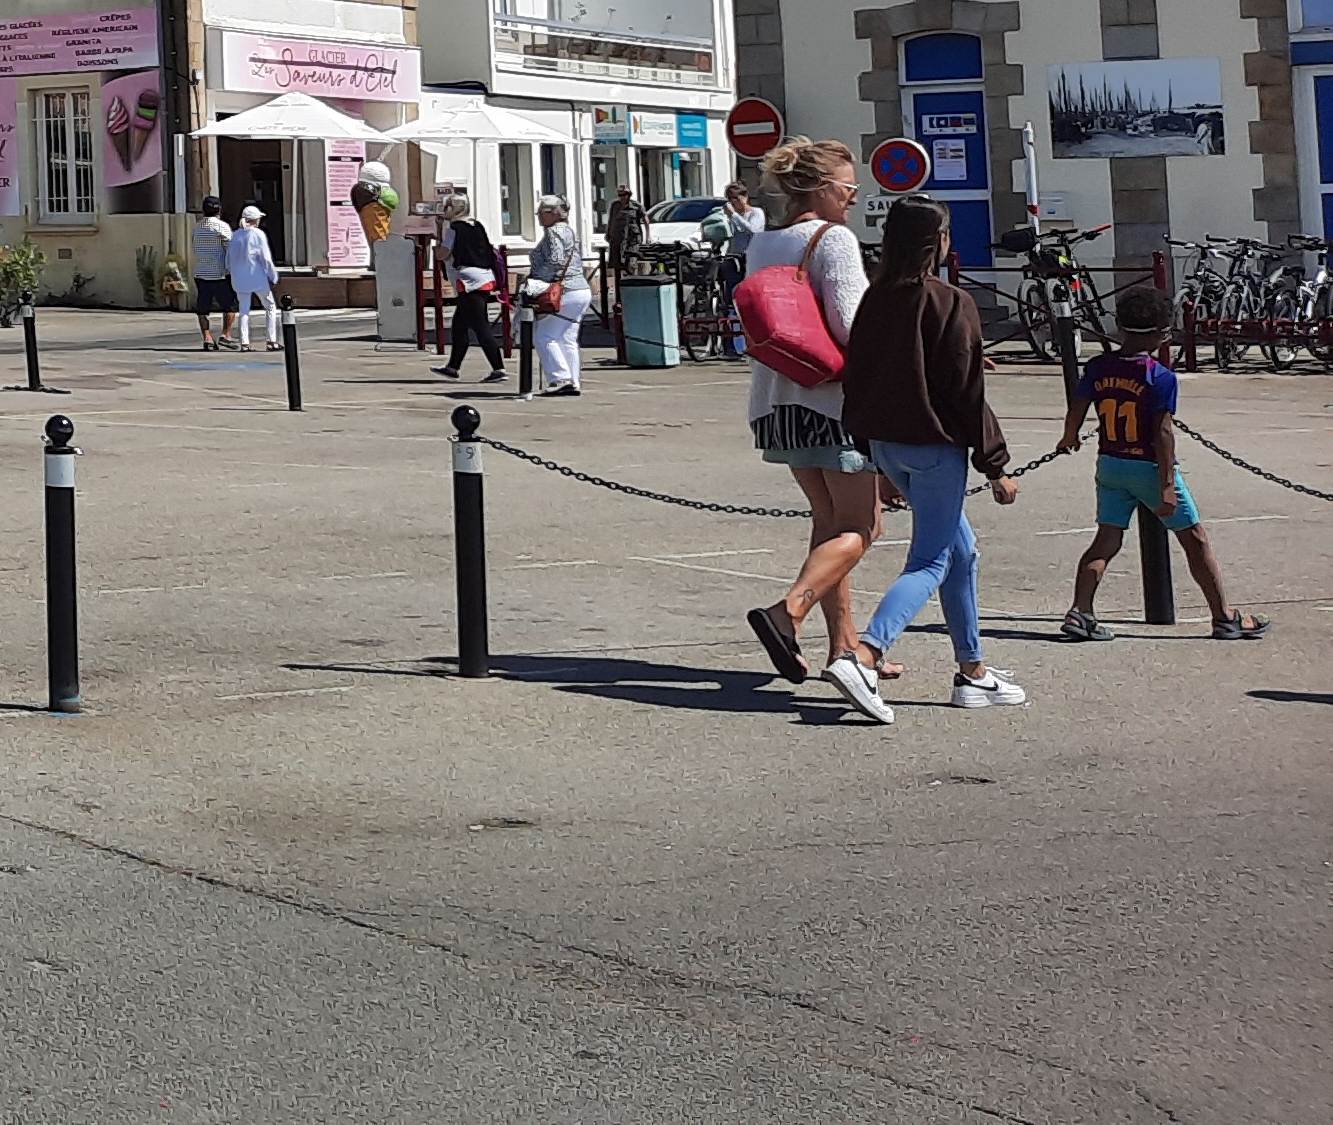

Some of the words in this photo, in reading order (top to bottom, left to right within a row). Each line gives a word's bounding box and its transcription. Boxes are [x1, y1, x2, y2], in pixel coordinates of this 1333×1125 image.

[275, 48, 346, 88] Saveurs
[308, 48, 347, 64] GLACIER
[866, 200, 894, 212] SAU
[1098, 398, 1139, 443] 11
